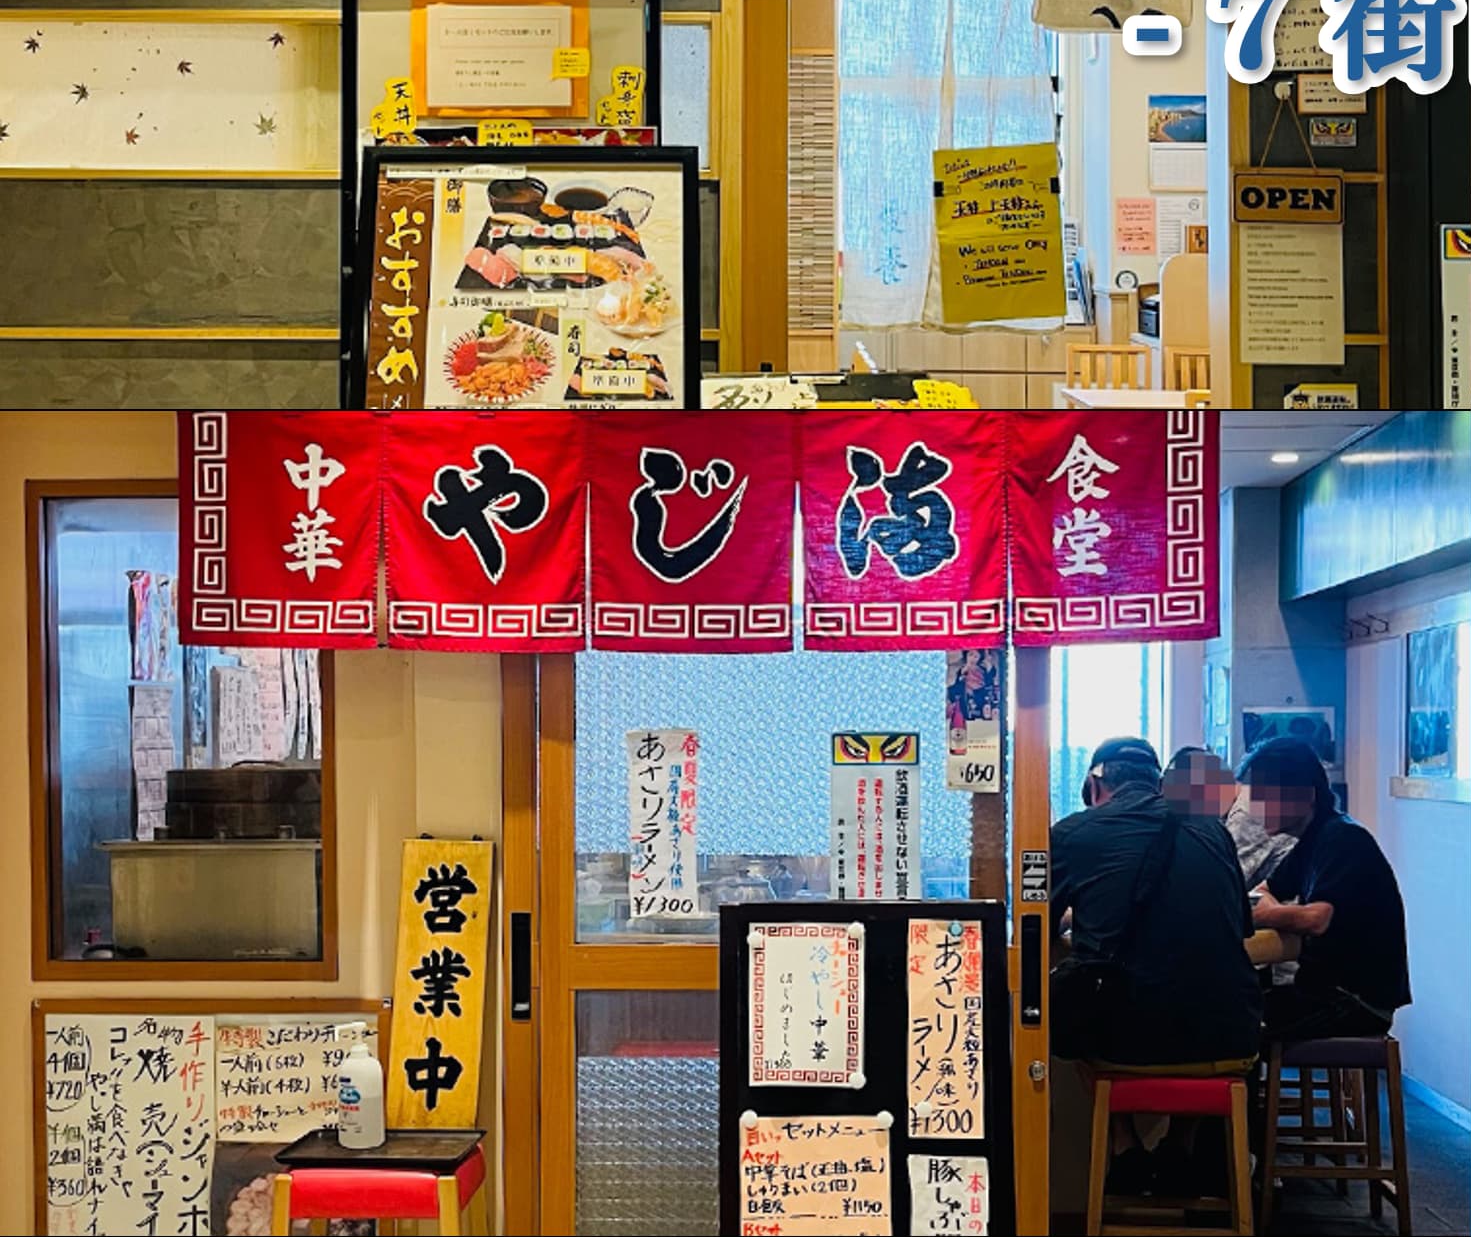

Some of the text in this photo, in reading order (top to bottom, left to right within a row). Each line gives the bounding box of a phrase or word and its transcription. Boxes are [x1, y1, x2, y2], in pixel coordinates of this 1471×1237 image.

[1241, 186, 1336, 211] OPEN
[376, 205, 425, 385] おすすめ
[283, 444, 345, 581] 中華
[1047, 435, 1119, 577] 食堂
[636, 732, 666, 894] あさりラーメン
[633, 896, 694, 915] ¥1300
[404, 864, 478, 1111] 営業中
[809, 945, 831, 1063] 冷やし中華
[781, 1122, 887, 1141] セットメニュー
[910, 1106, 973, 1136] ¥1300
[928, 1158, 969, 1231] 豚しゃぶ
[965, 1172, 987, 1235] 本日の
